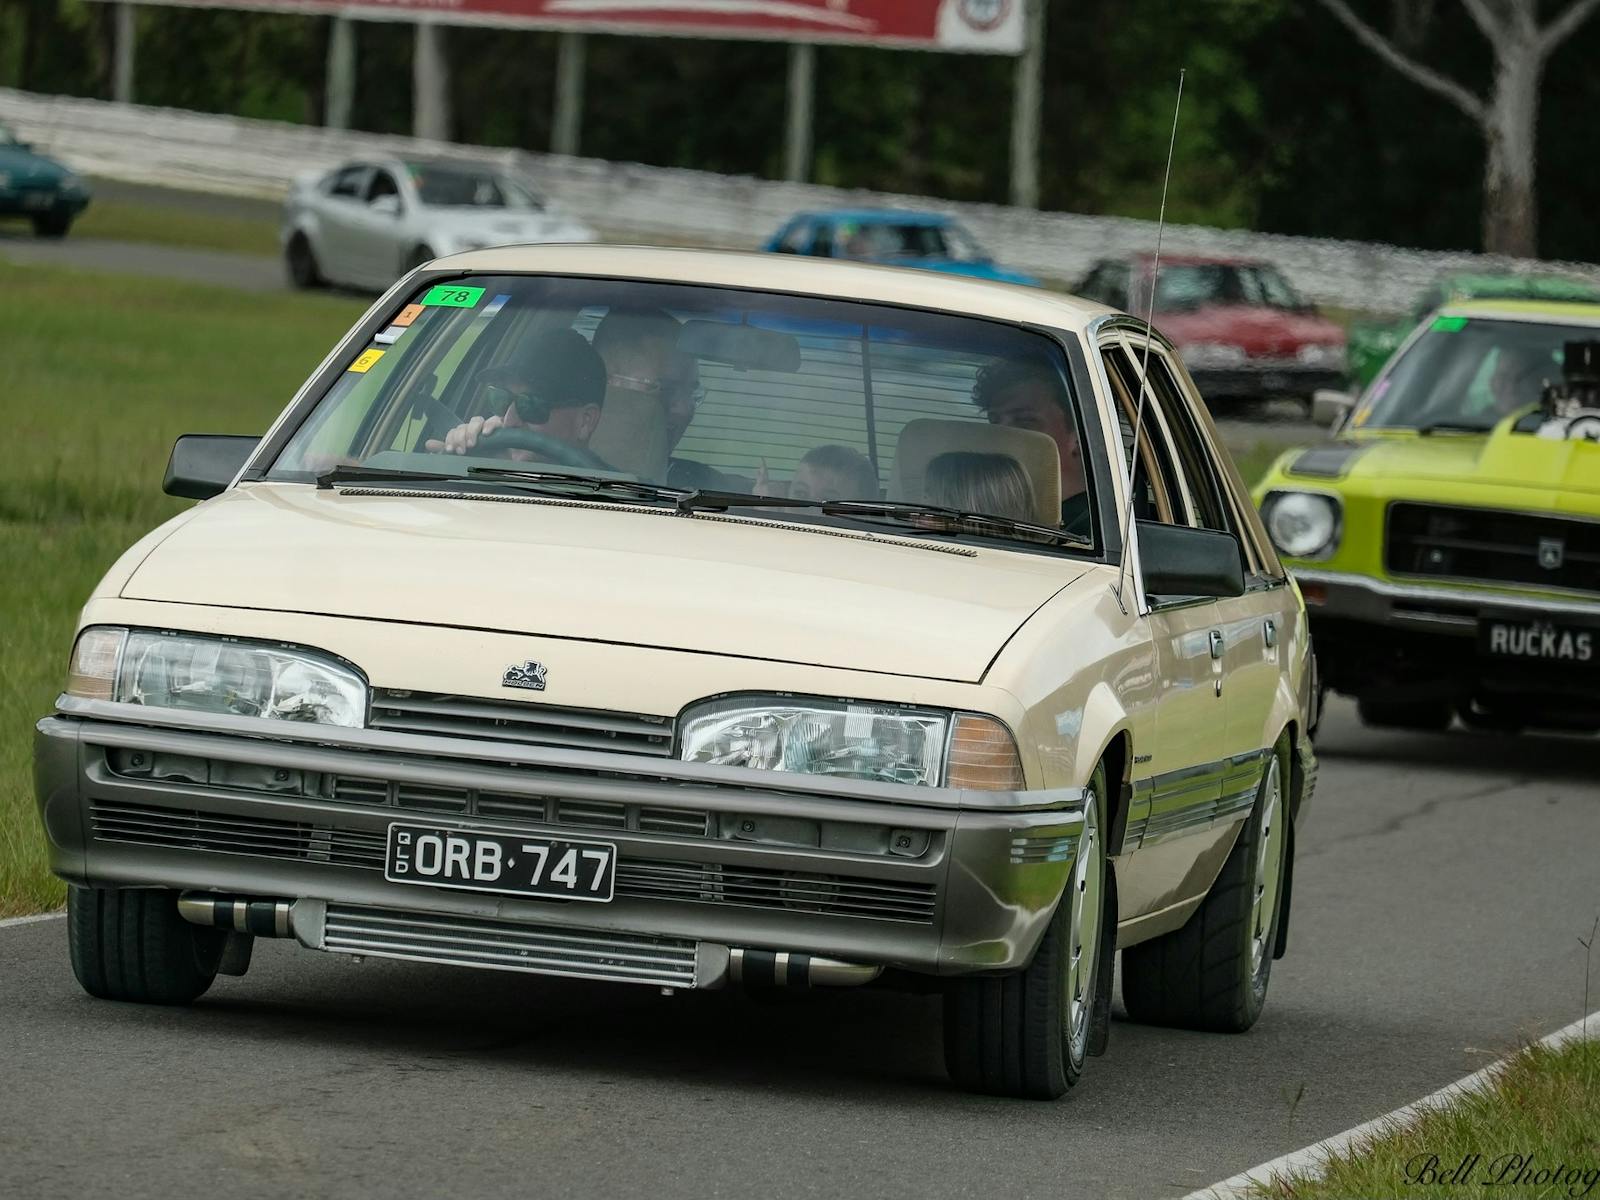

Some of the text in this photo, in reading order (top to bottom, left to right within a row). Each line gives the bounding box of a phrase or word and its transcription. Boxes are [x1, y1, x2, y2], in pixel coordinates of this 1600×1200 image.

[440, 290, 470, 303] 78
[1490, 624, 1592, 660] RUCKAS
[395, 832, 412, 874] QLD
[414, 834, 610, 892] ORB 747
